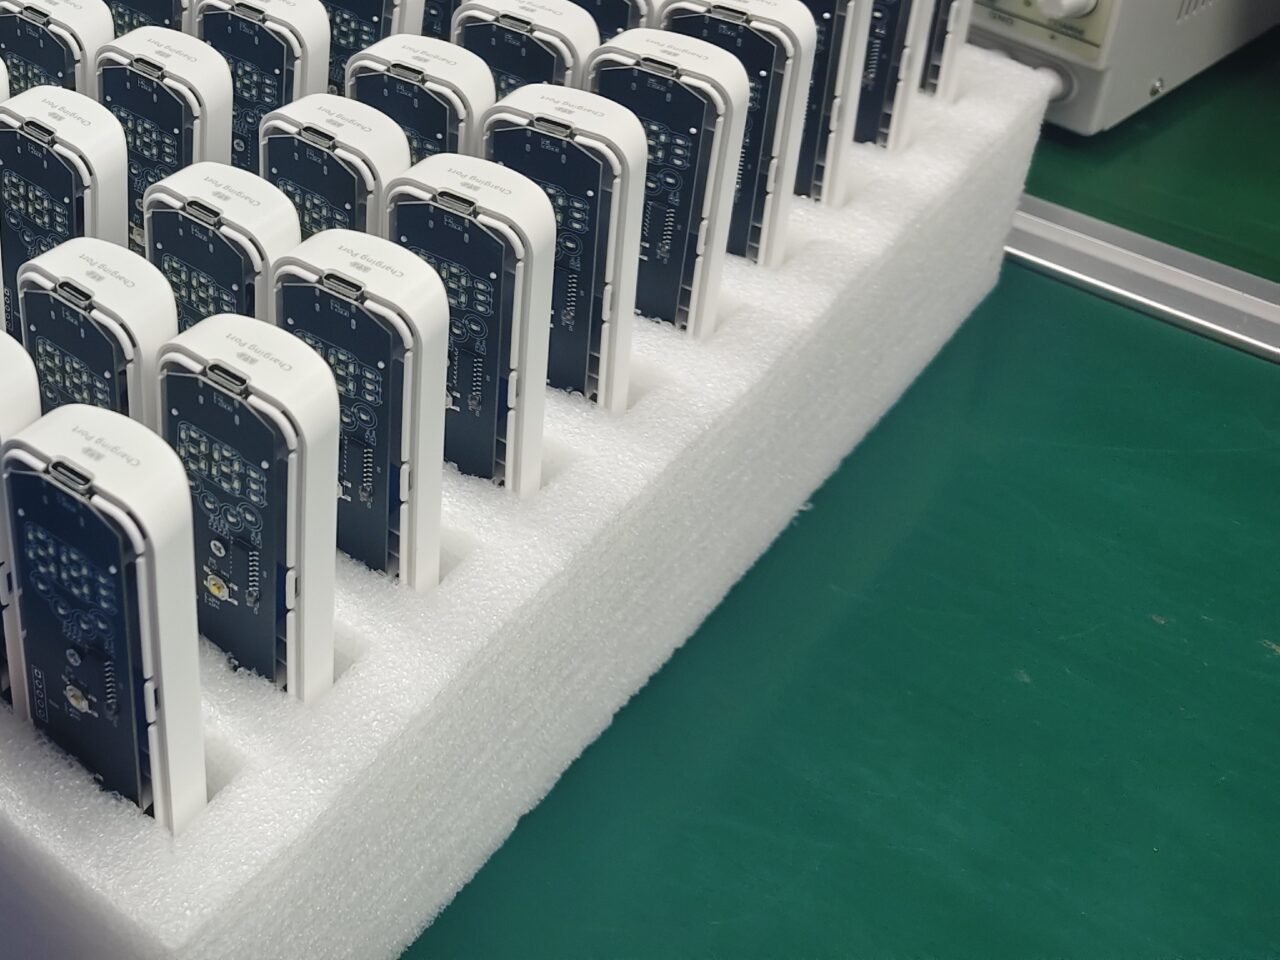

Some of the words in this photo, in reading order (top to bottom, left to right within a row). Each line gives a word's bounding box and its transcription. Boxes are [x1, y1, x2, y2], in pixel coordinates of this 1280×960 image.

[419, 50, 458, 66] Charging
[57, 105, 92, 127] Charging
[316, 105, 337, 117] Port
[560, 100, 606, 118] Charging
[334, 112, 373, 133] Charging
[203, 175, 224, 189] Port
[447, 167, 469, 180] Port
[468, 175, 513, 196] Charging
[221, 184, 262, 207] Charging
[78, 253, 99, 267] Port
[337, 244, 361, 259] Port
[359, 253, 405, 278] Charging
[96, 263, 136, 288] Charging
[225, 332, 249, 348] Port
[247, 343, 294, 372] Charging
[71, 425, 96, 442] Port
[93, 436, 142, 468] Charging
